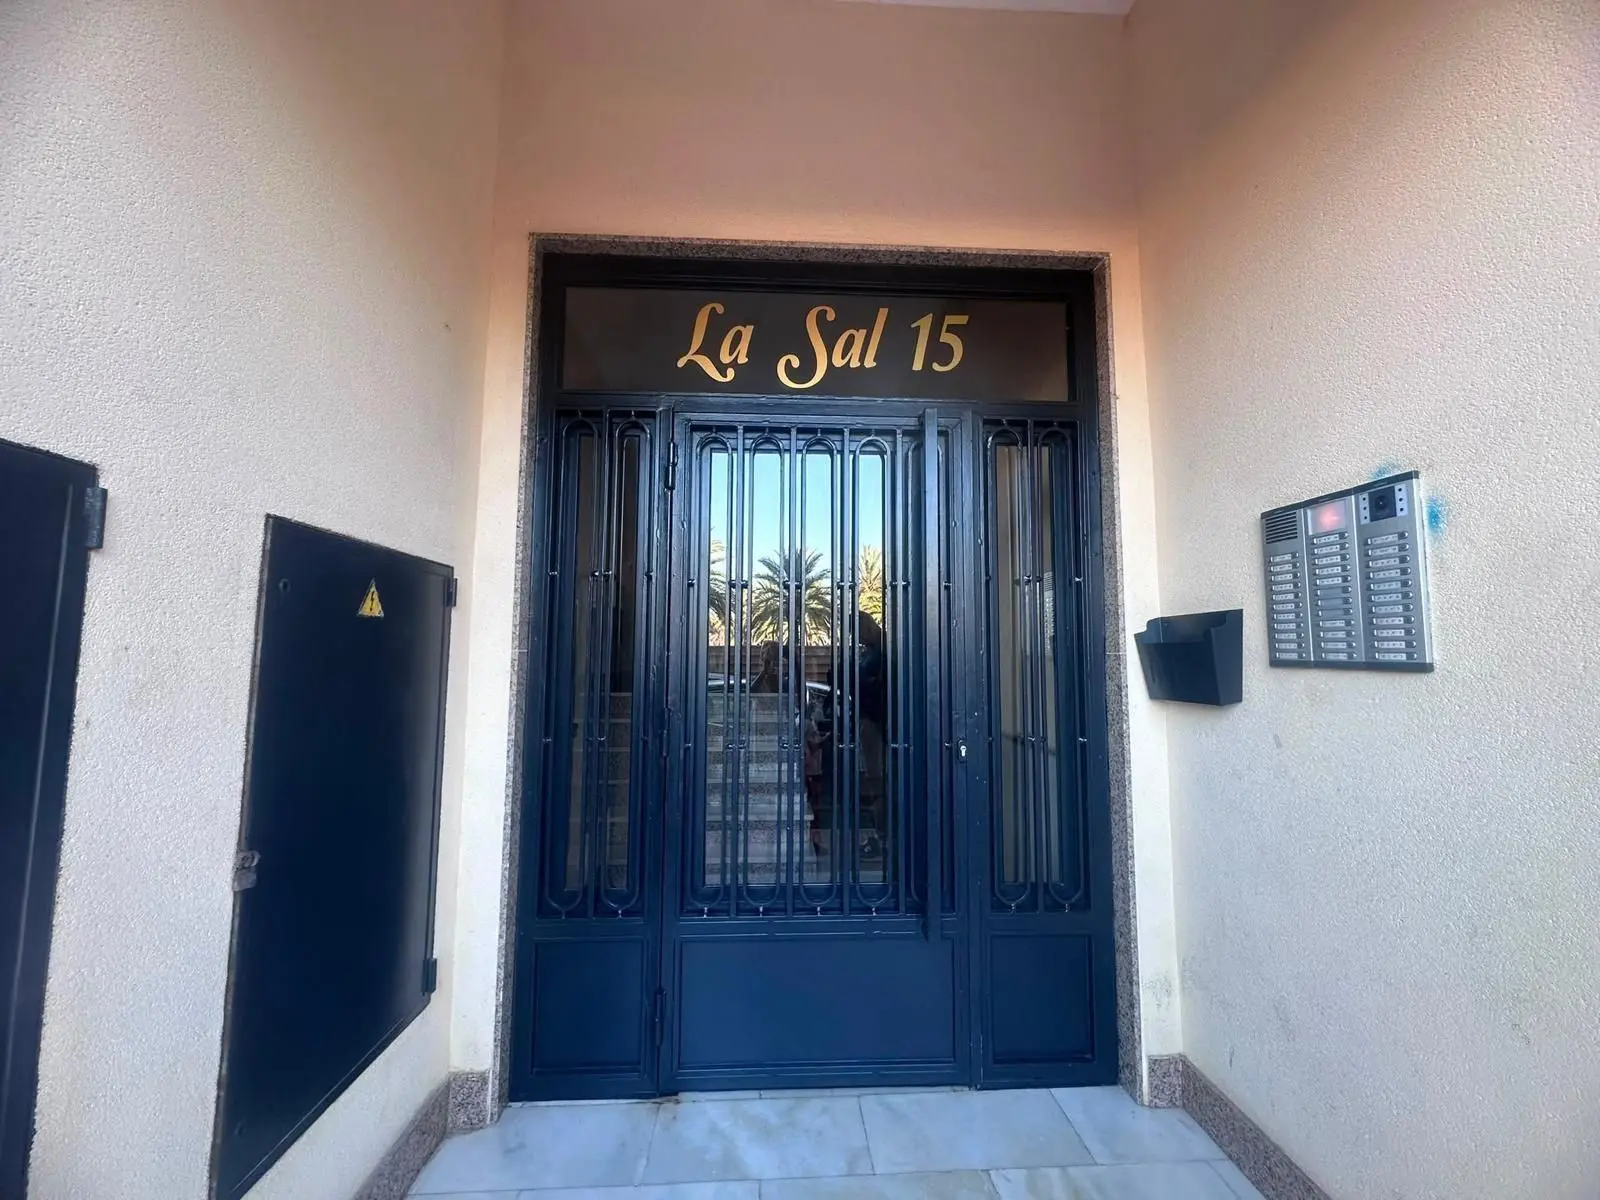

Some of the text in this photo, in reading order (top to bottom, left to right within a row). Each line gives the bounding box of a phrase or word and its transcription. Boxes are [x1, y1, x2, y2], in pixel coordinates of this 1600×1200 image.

[677, 302, 970, 389] La Sal 15
